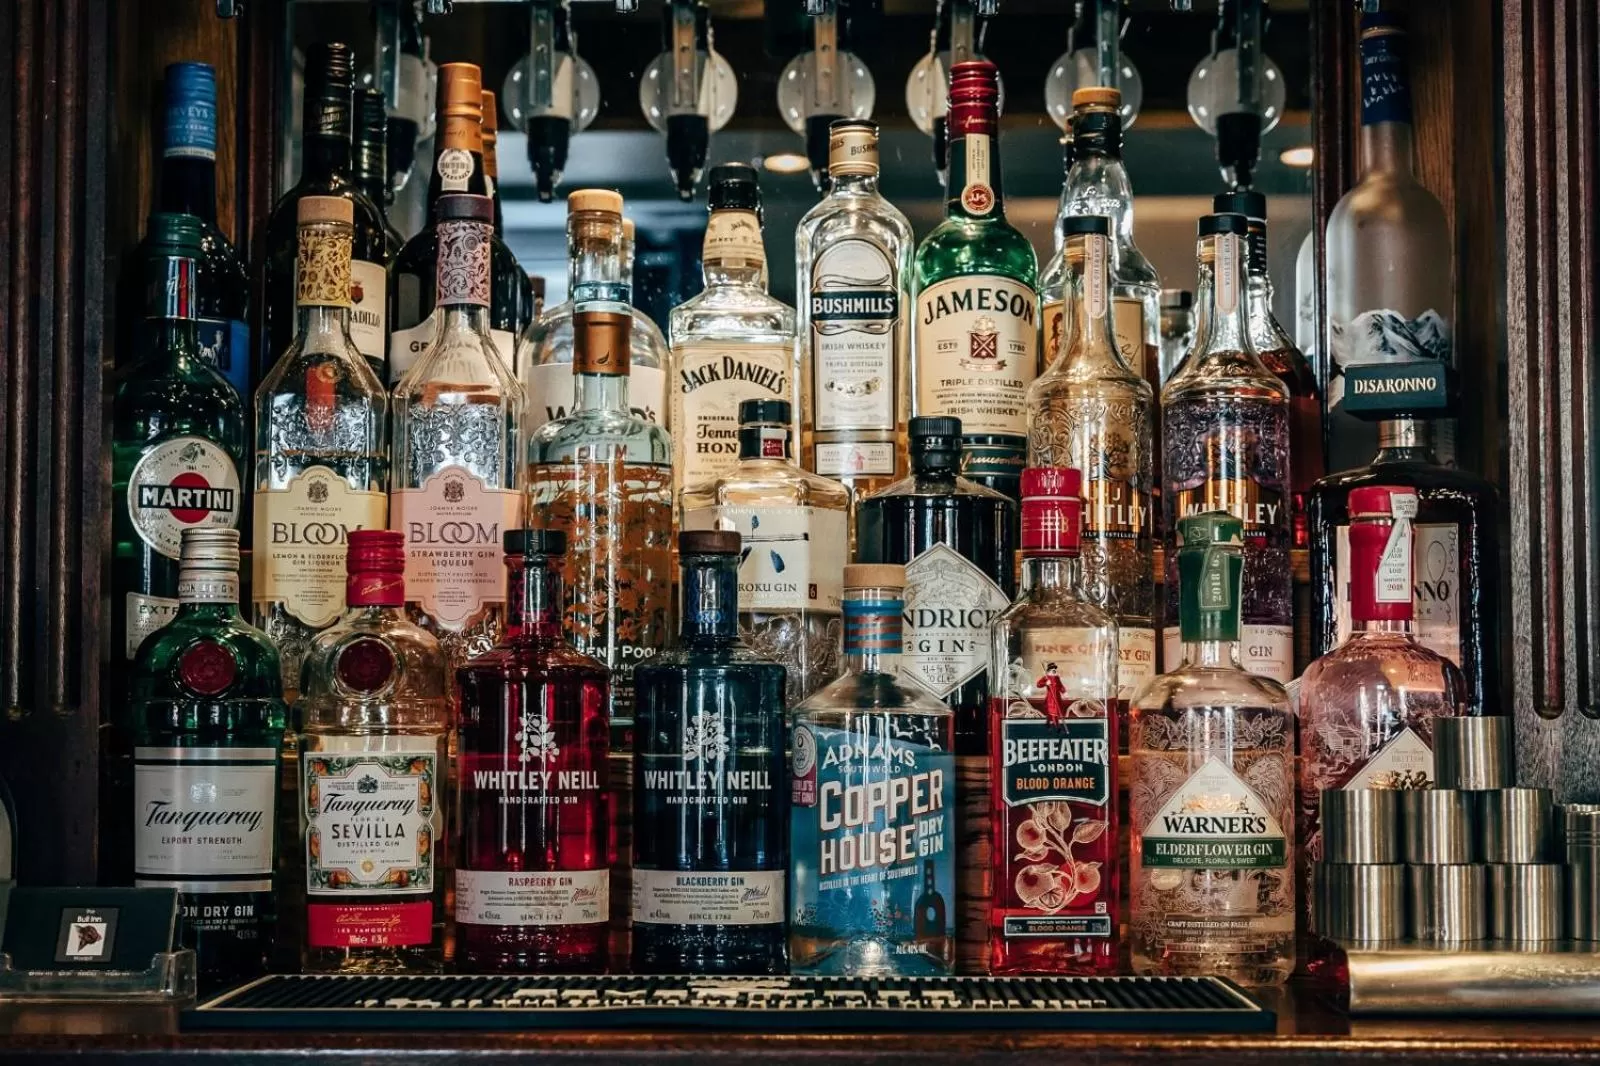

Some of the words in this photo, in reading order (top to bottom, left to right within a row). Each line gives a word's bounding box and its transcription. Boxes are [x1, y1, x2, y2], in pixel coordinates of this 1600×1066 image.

[812, 297, 895, 315] BUSHMILLS
[924, 288, 1035, 326] JAMESON
[846, 342, 886, 350] WHISKEY
[680, 362, 722, 394] JACK
[722, 355, 787, 394] DANIEL'S
[940, 379, 976, 388] TRIPLE
[977, 379, 1024, 389] DISTILLED
[1354, 376, 1437, 394] DISARONNO
[947, 407, 973, 415] IRISH
[976, 407, 1020, 416] WHISKEY
[142, 486, 232, 511] MARTINI
[1080, 502, 1147, 526] HITLEY
[409, 521, 500, 544] BLOOM
[431, 559, 475, 567] LIQUEUR
[738, 583, 771, 592] ROKU
[773, 583, 797, 592] GIN
[918, 639, 965, 653] GIN
[1249, 645, 1273, 657] GIN
[1134, 649, 1151, 662] GIN
[1003, 738, 1109, 767] BEEFEATER
[838, 765, 901, 774] SOUTHWOLD
[1030, 763, 1084, 773] LONDON
[473, 770, 553, 790] WHITLEY
[558, 770, 600, 790] NEILL
[644, 770, 720, 790] WHITLEY
[727, 770, 772, 790] NEILL
[1015, 777, 1050, 790] BLOOD
[1053, 777, 1096, 790] ORANGE
[323, 793, 416, 817] Tanqueray
[498, 796, 560, 804] HANDCRAFTED
[563, 796, 578, 804] GIN
[666, 796, 729, 804] HANDCRAFTED
[732, 796, 748, 804] GIN
[820, 768, 944, 832] COPPER
[145, 800, 264, 832] Tanqueray
[331, 823, 406, 839] SEVILLA
[918, 815, 944, 838] DRY
[1163, 815, 1267, 834] WARNER'S
[820, 824, 916, 875] HOUSE
[918, 834, 944, 858] GIN
[1156, 843, 1252, 856] ELDERFLOWER
[1253, 843, 1274, 855] GIN
[1172, 857, 1204, 865] DELICATE,
[508, 877, 556, 886] RASPBERRY
[559, 877, 573, 886] GIN
[676, 876, 728, 887] BLACKBERRY
[731, 876, 745, 886] GIN
[203, 906, 230, 917] DRY
[234, 905, 254, 917] GIN
[688, 913, 714, 921] SINCE
[77, 915, 90, 923] Bull
